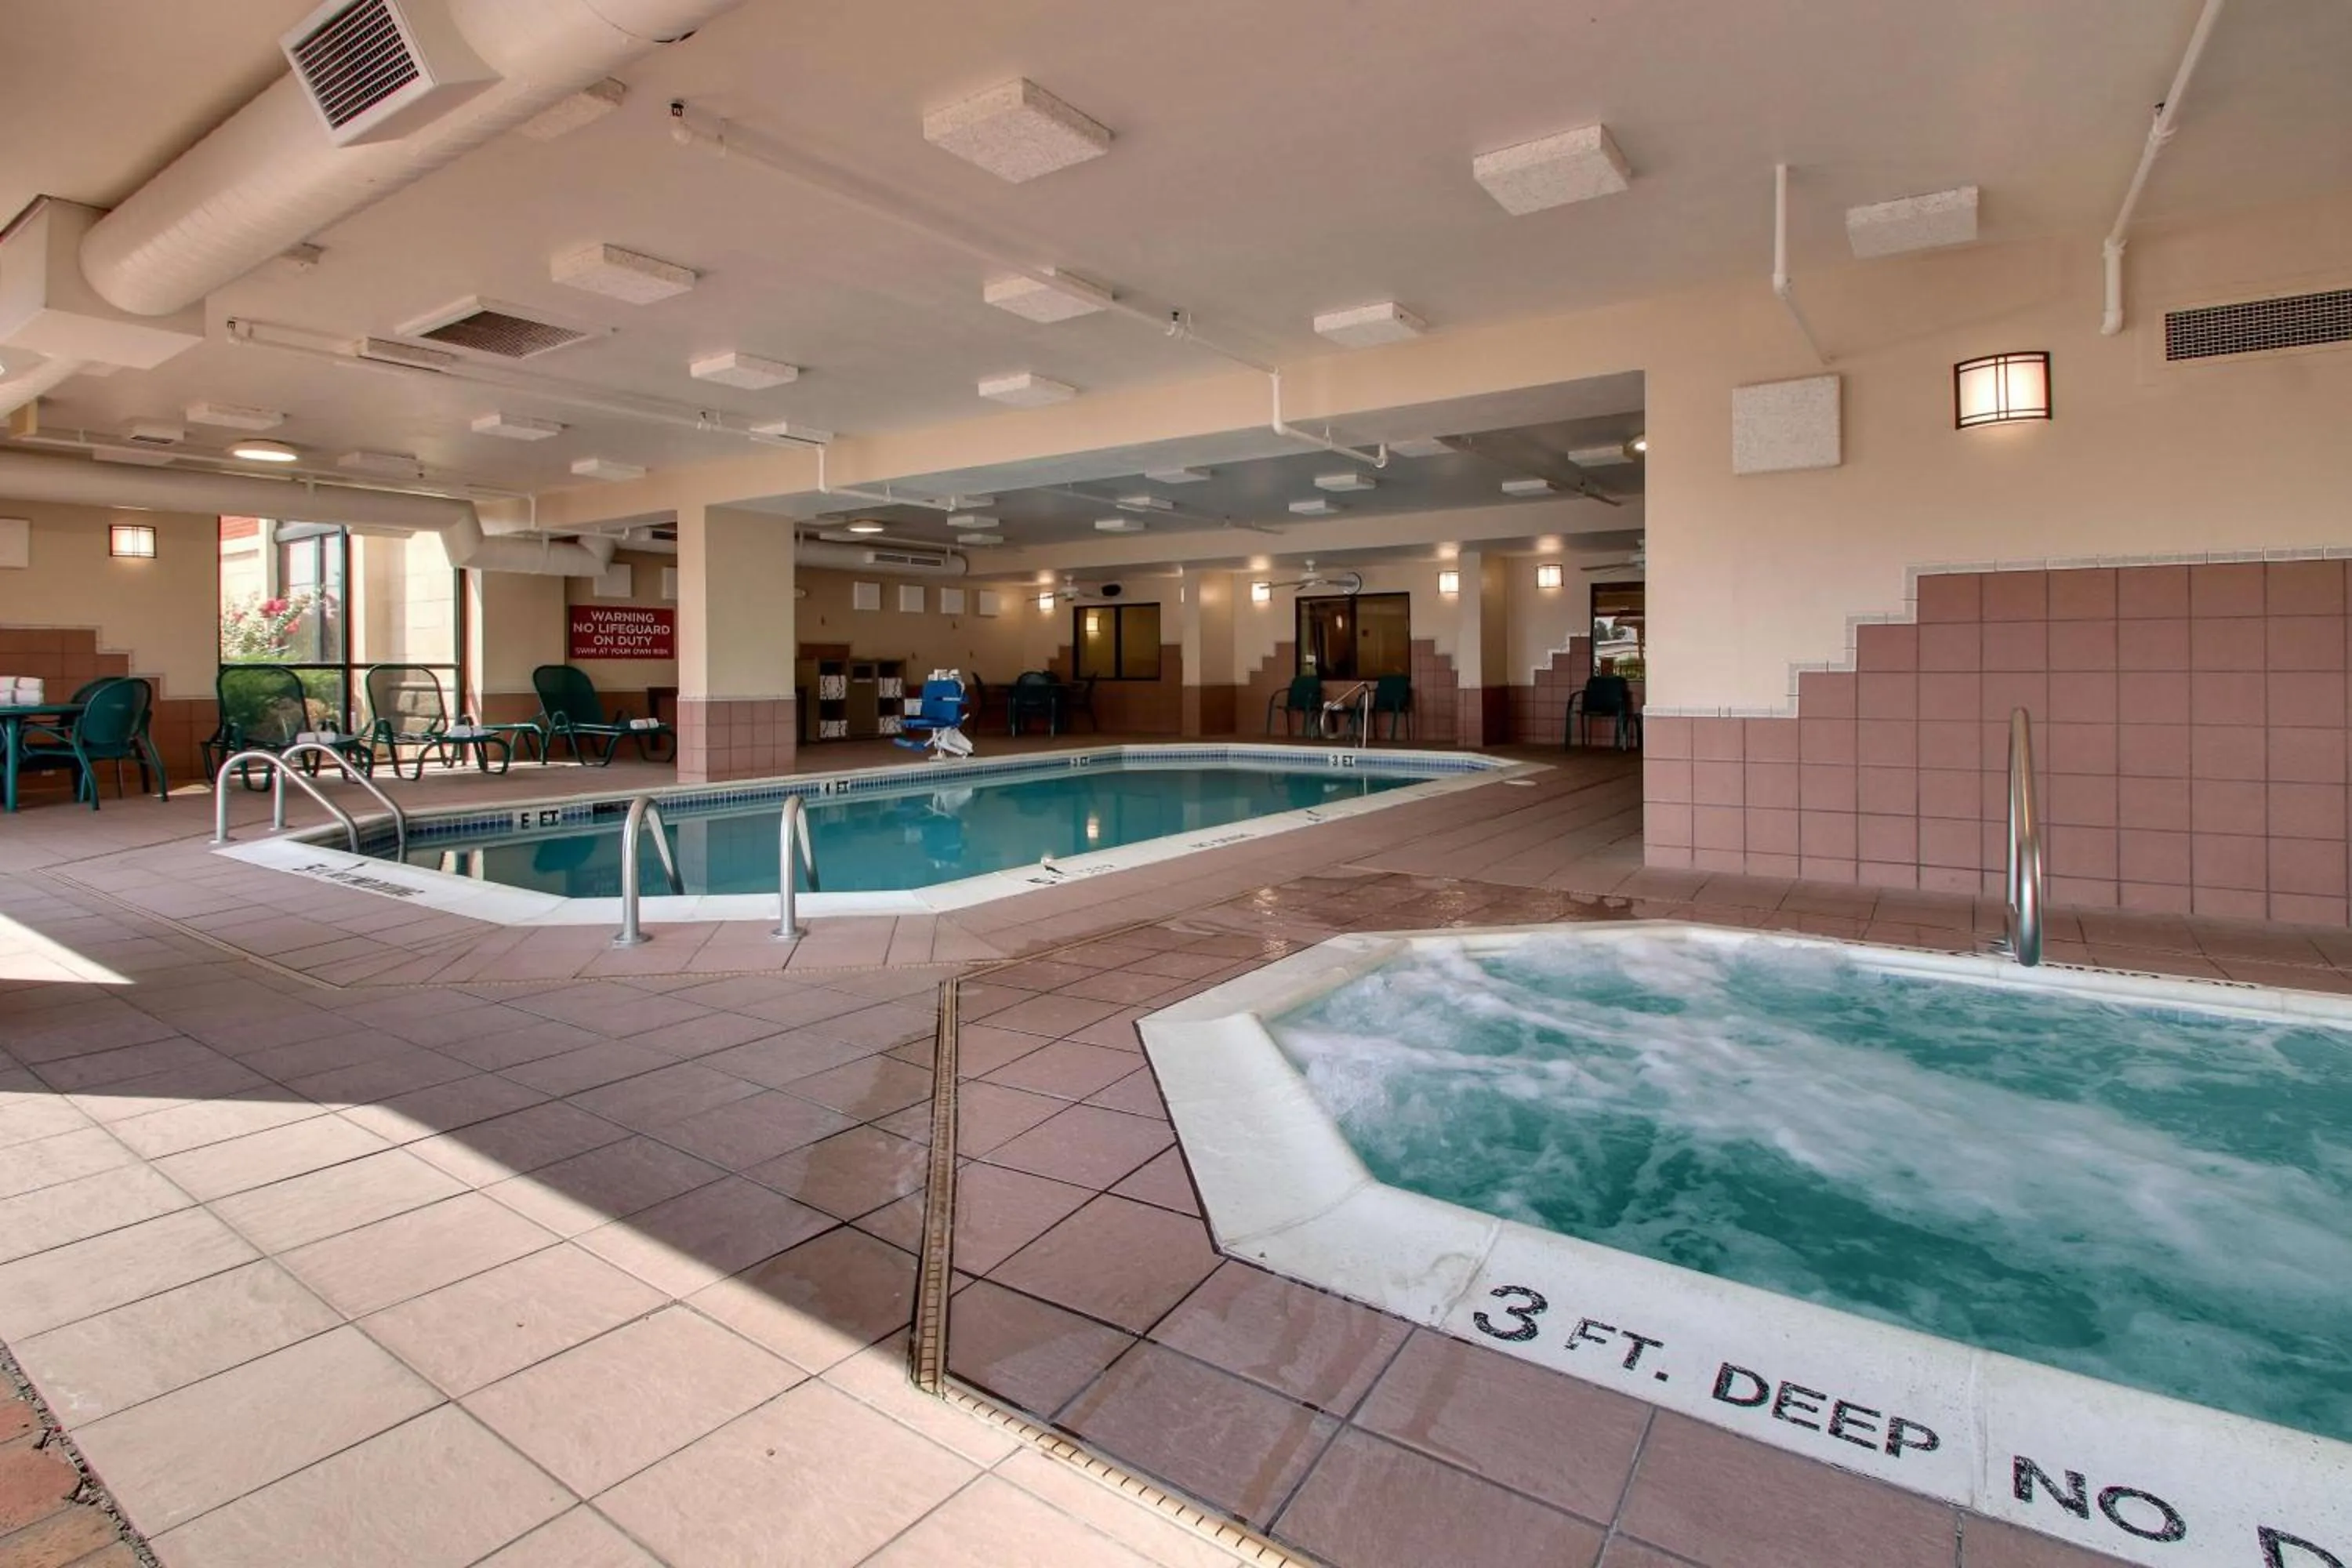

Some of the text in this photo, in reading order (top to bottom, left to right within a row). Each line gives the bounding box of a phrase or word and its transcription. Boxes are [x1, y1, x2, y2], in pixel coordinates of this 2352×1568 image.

[591, 611, 655, 622] WARNING
[573, 622, 670, 635] NO LIFEGUARD
[593, 635, 652, 646] ON DUTY
[1473, 1285, 1548, 1342] 3
[1565, 1317, 1668, 1382] FT.
[1712, 1362, 1940, 1458] DEEP
[2013, 1454, 2187, 1542] NO
